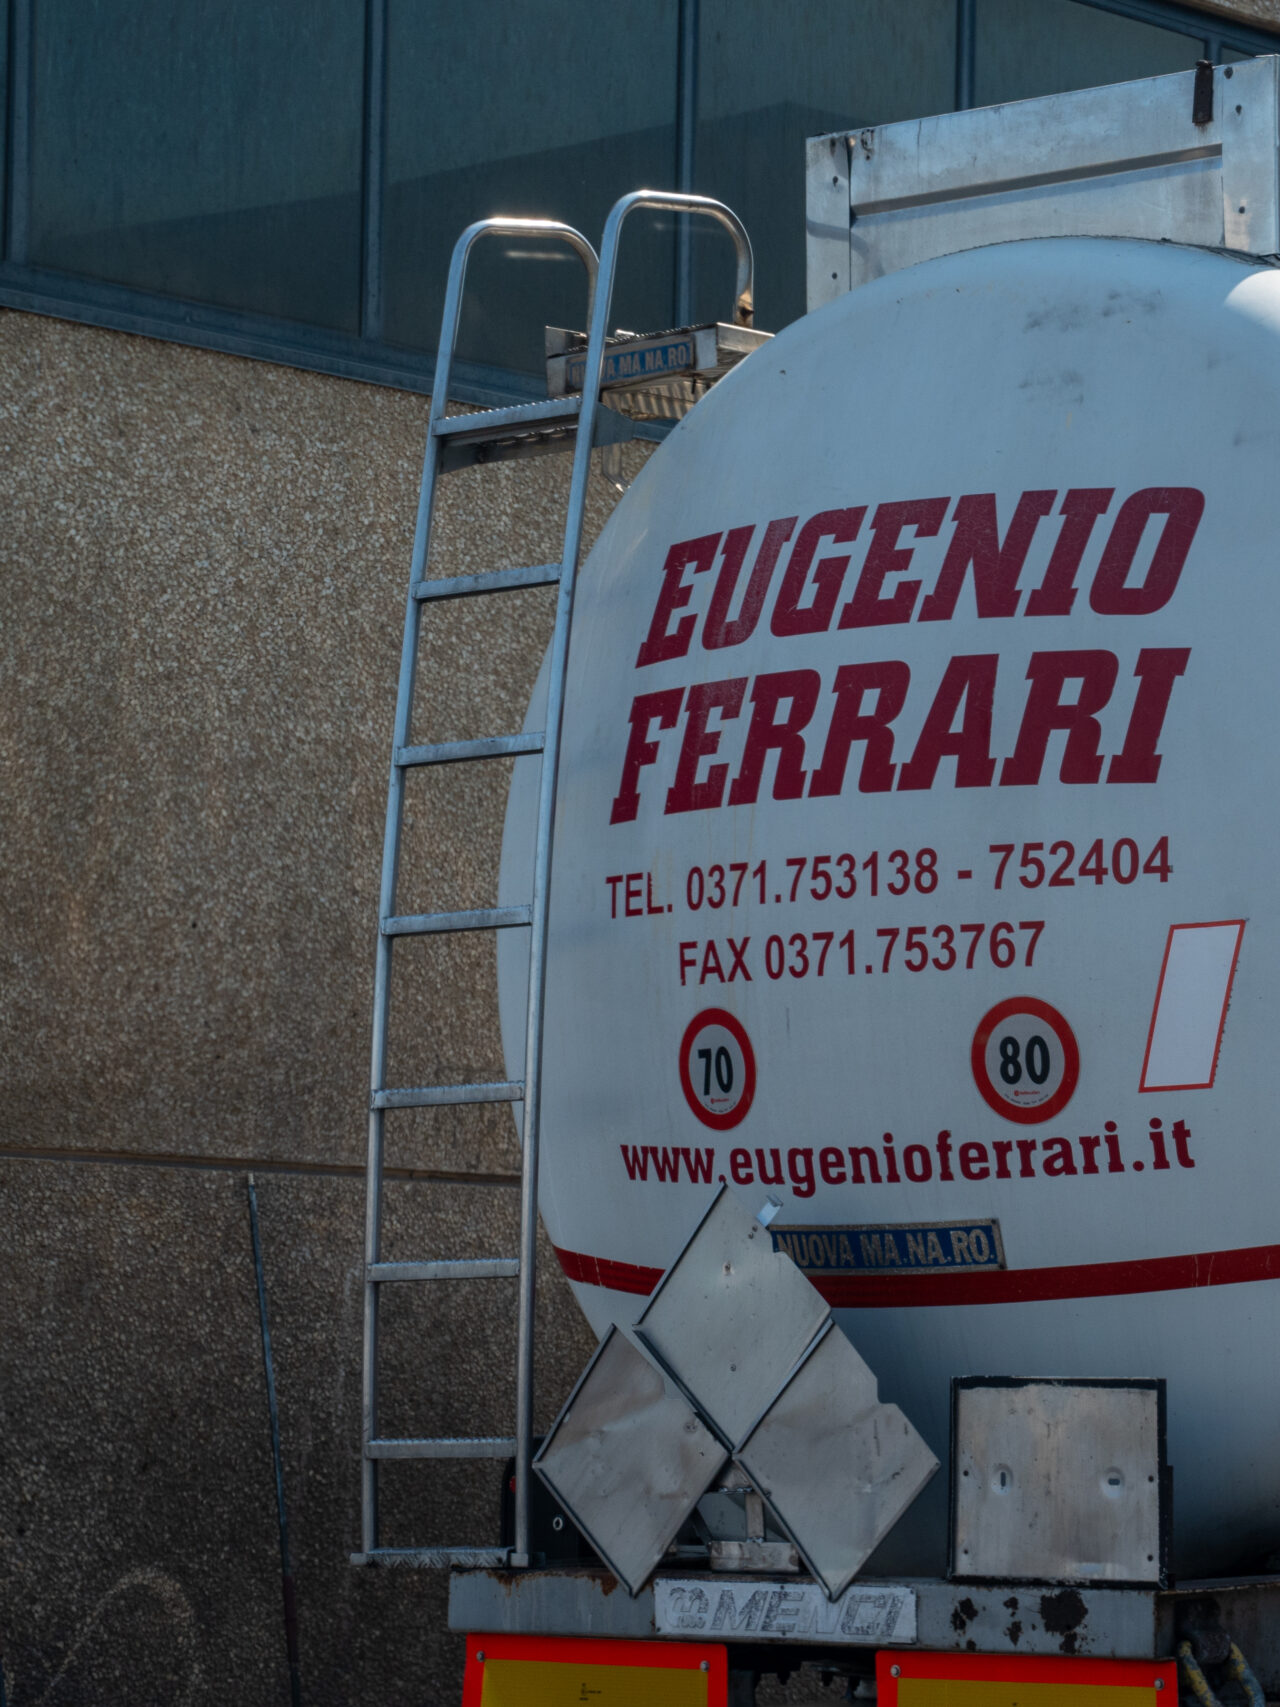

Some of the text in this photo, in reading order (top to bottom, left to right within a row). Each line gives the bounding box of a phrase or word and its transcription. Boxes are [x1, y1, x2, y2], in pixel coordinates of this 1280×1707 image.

[635, 487, 1205, 669] EUGENIO
[609, 647, 1192, 825] FERRARI
[606, 872, 673, 919] TEL.
[686, 848, 939, 911] 0371.753138
[989, 836, 1174, 889] 752404
[679, 921, 1045, 986] FAX 0371.753767
[698, 1046, 733, 1096] 70
[1000, 1035, 1050, 1085] 80
[620, 1118, 1195, 1198] www.eugenioferrari.it
[776, 1229, 995, 1267] NUOVA MA.NA.RO.
